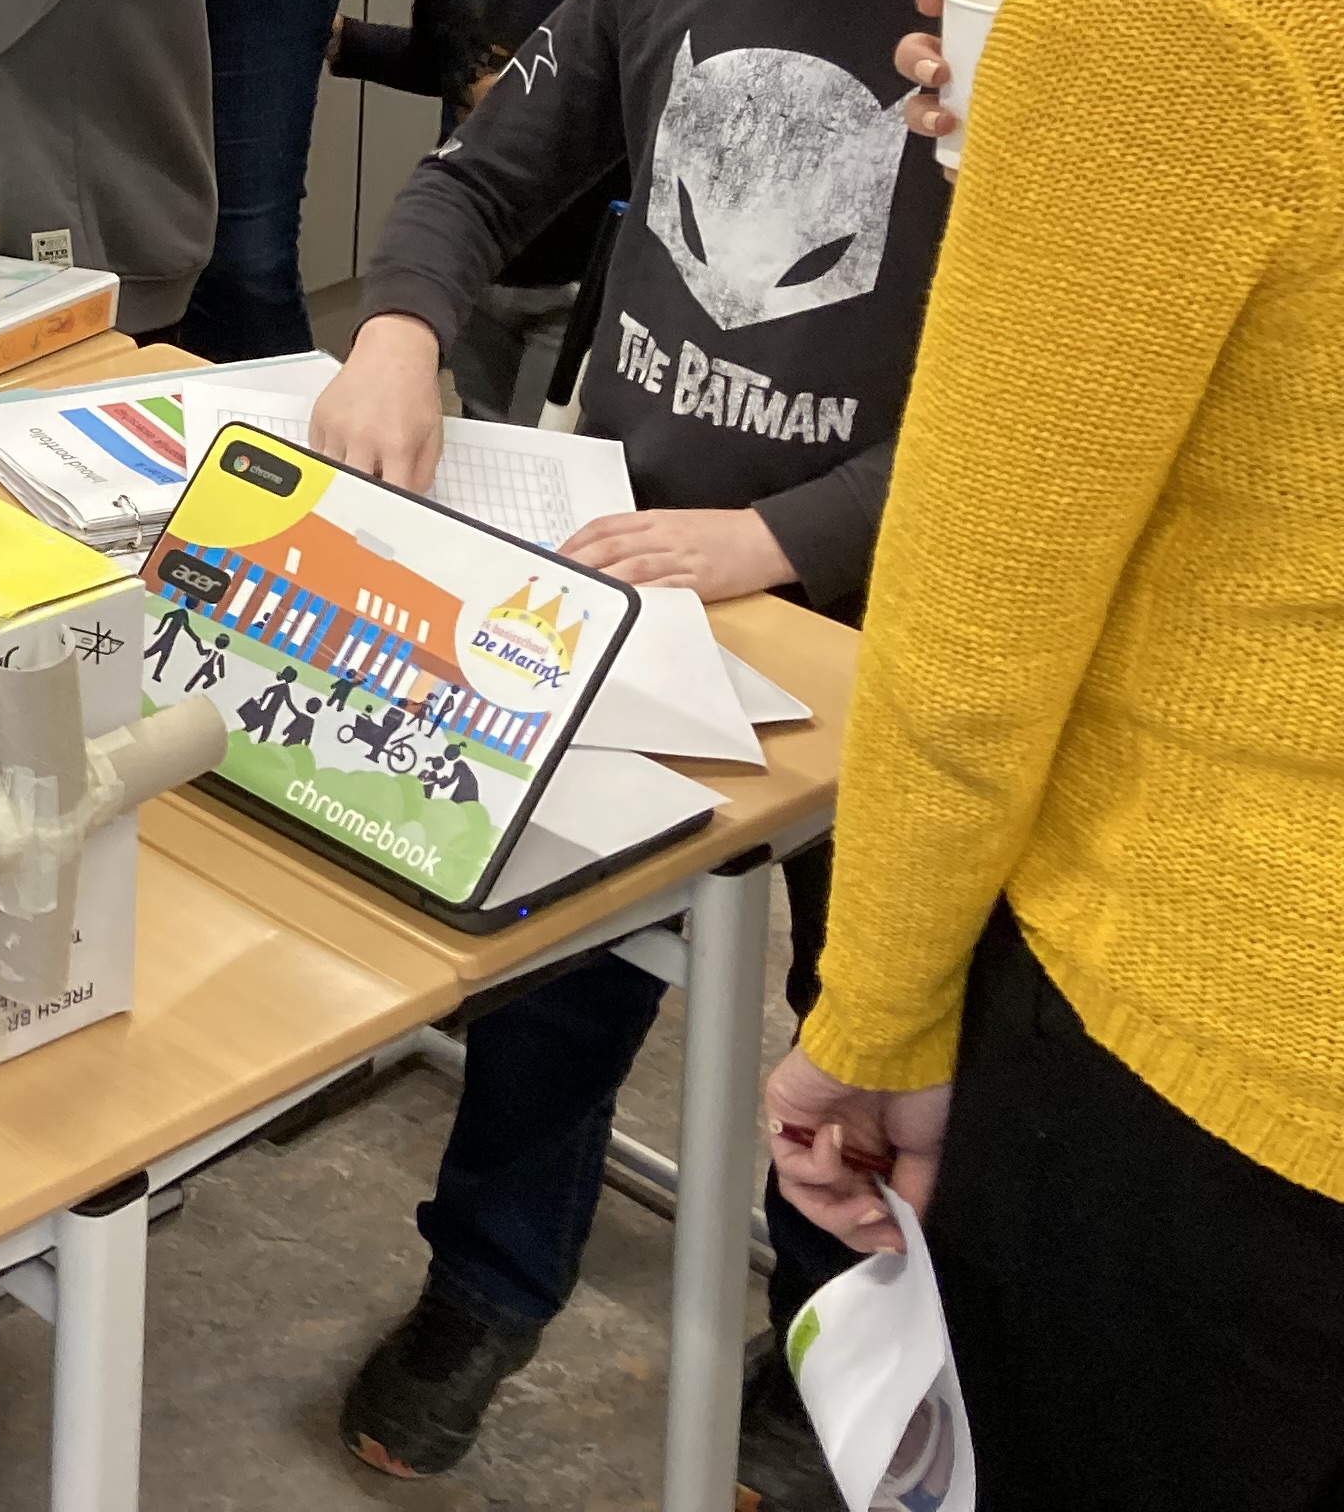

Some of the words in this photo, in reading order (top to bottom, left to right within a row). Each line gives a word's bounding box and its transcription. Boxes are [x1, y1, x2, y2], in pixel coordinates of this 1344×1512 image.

[616, 310, 671, 394] THE
[672, 339, 859, 444] BATMAN
[29, 427, 75, 466] portfolio
[68, 456, 109, 484] Inhoud
[249, 465, 284, 485] chrome
[172, 564, 222, 592] acer
[472, 630, 497, 652] De
[492, 625, 549, 656] basisschool
[286, 780, 441, 876] chromebook
